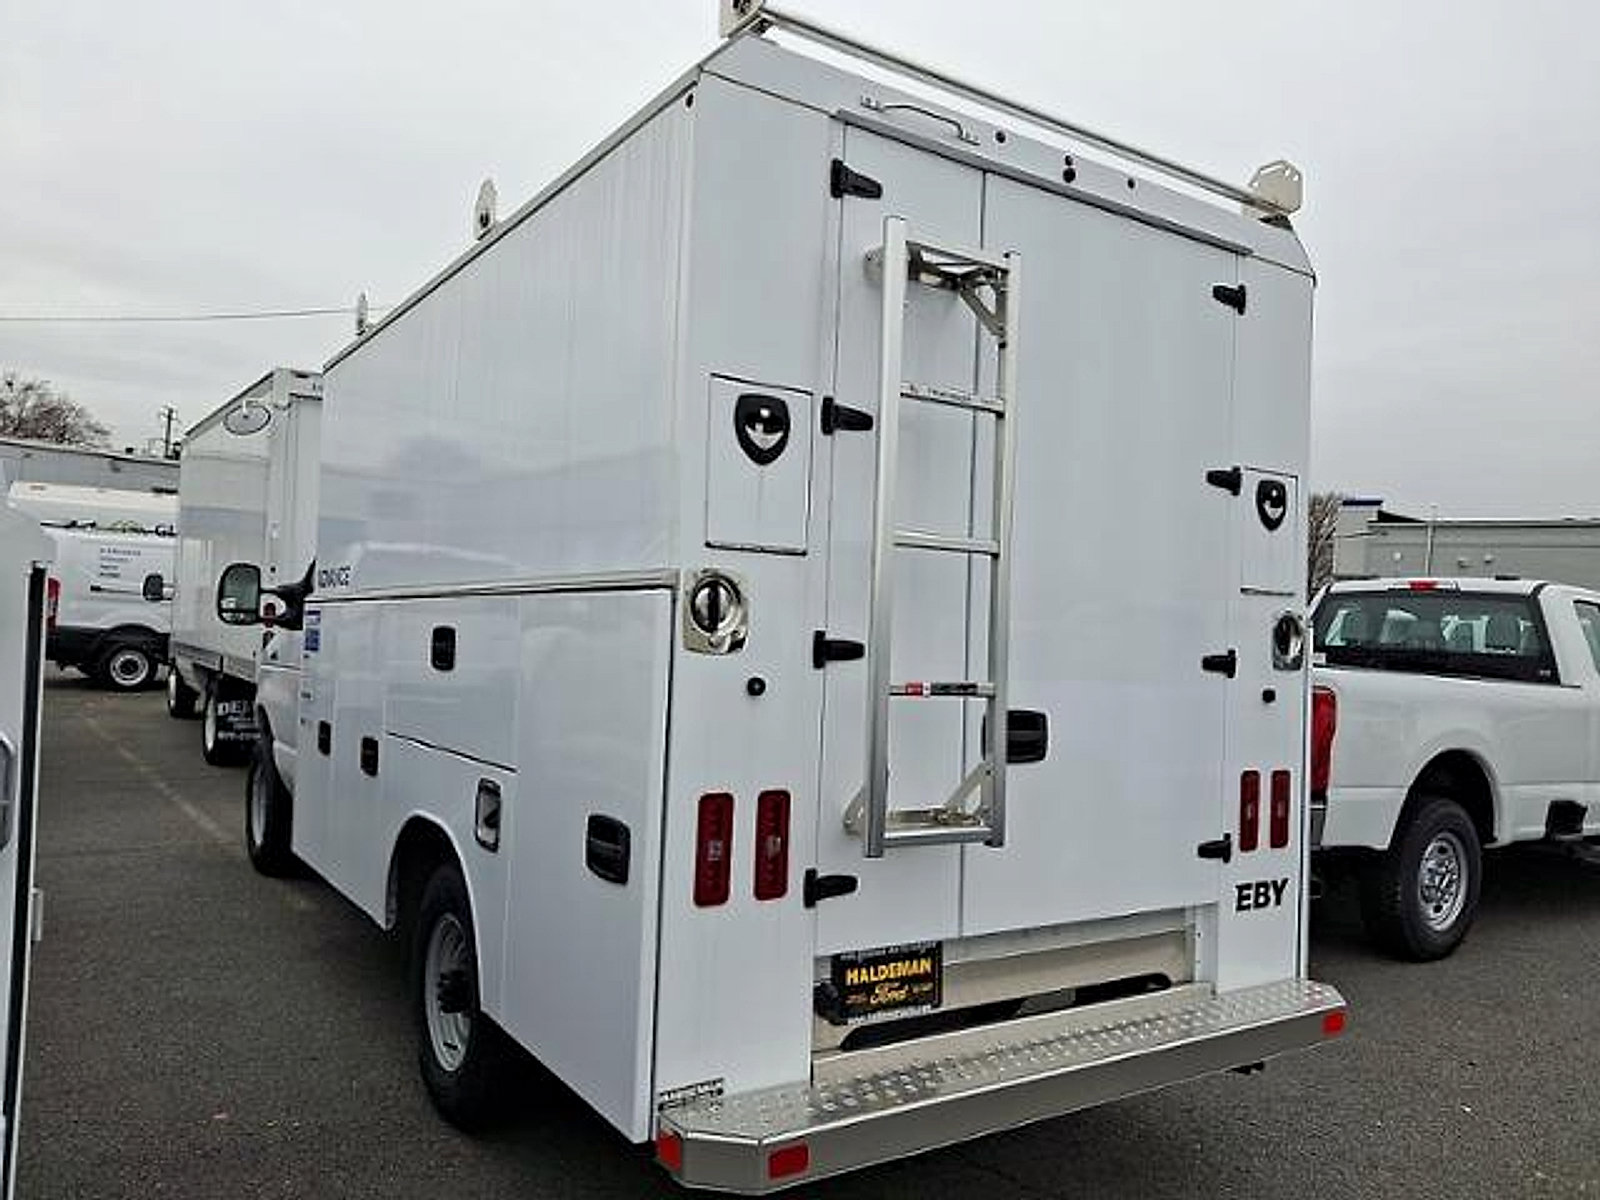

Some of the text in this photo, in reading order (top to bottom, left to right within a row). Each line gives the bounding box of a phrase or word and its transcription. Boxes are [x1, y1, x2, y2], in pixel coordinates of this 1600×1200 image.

[1235, 877, 1289, 911] EBY
[845, 957, 932, 986] HALDEMAN
[870, 984, 909, 1004] Ford
